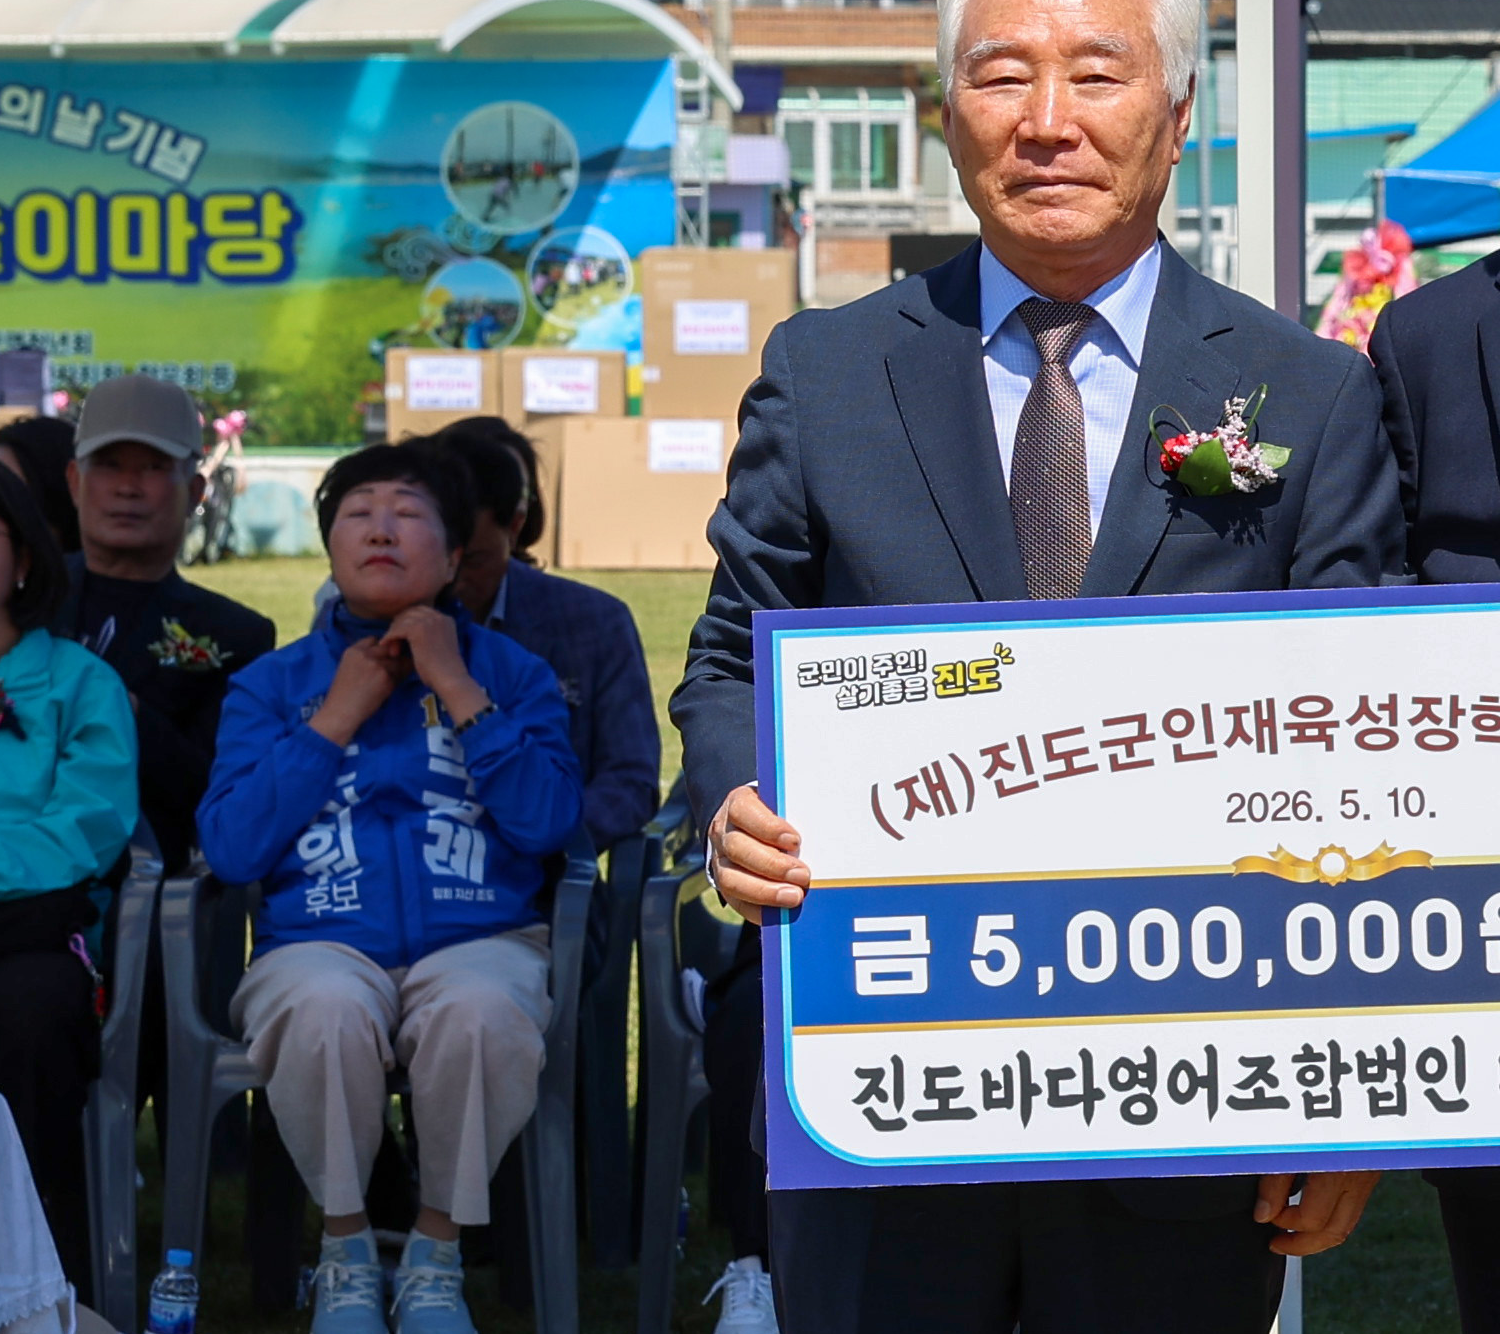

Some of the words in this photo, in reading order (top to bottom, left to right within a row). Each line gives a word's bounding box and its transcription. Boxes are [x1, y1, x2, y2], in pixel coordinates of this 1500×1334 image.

[50, 94, 103, 151] 날
[104, 108, 206, 186] 기념
[798, 655, 867, 688] 군민이
[871, 648, 927, 678] 주인!
[835, 676, 927, 710] 살기좋은
[932, 658, 1003, 699] 진도
[1226, 787, 1324, 824] 2026.
[1340, 788, 1372, 822] 5.
[1387, 785, 1437, 819] 10.
[304, 880, 363, 918] 후보
[852, 915, 931, 996] 금
[851, 1035, 1471, 1133] 진도바다영어조합법인
